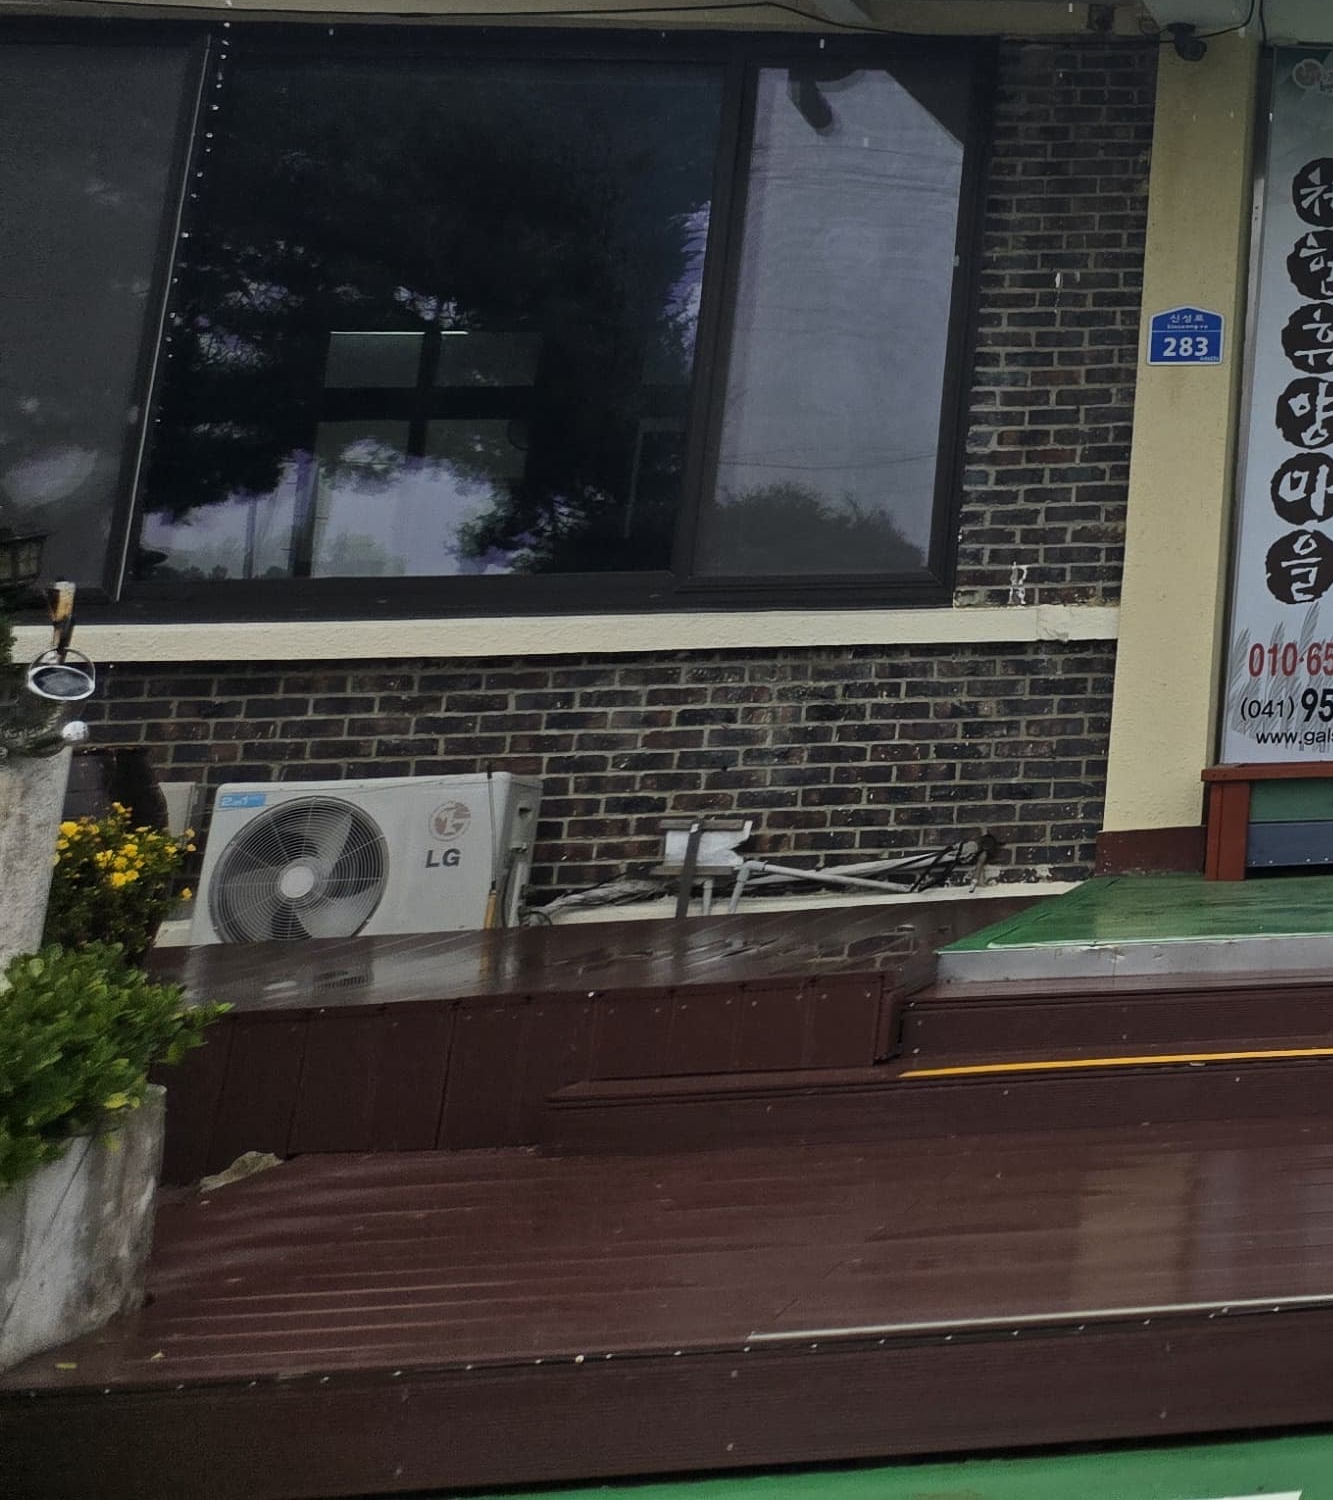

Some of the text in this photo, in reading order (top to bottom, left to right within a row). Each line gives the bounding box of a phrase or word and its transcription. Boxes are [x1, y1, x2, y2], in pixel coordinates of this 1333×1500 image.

[1163, 337, 1208, 357] 283
[1240, 696, 1295, 721] (041)
[425, 848, 461, 869] LG
